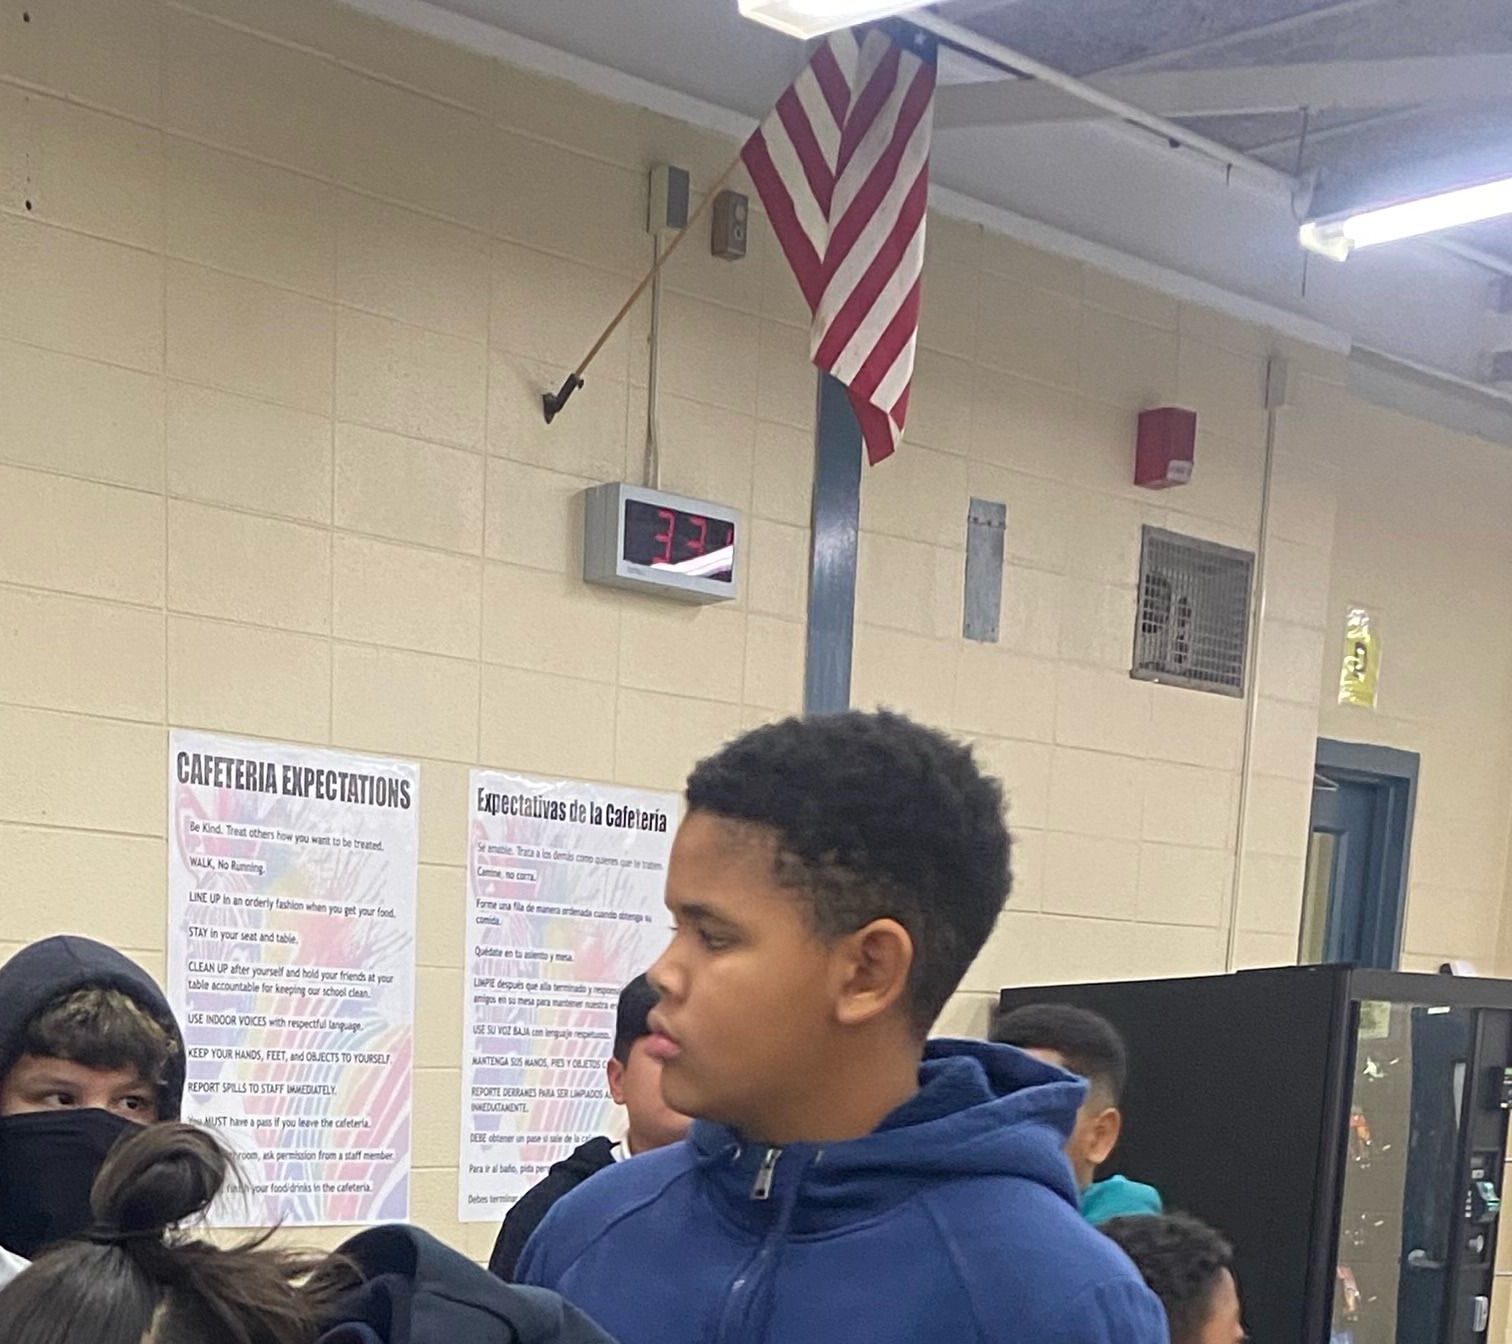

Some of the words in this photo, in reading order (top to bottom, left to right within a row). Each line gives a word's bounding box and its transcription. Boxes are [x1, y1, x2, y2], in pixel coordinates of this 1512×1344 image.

[176, 751, 277, 794] CAFETERIA
[282, 765, 411, 809] EXPECTATIONS
[477, 788, 566, 822] Expectativas
[569, 800, 586, 823] de
[590, 802, 602, 825] la
[606, 804, 667, 833] Cafetería
[190, 821, 200, 832] Be
[202, 823, 223, 835] Kind.
[227, 825, 246, 837] Treat
[249, 827, 274, 840] others
[277, 830, 293, 842] how
[295, 832, 309, 844] you
[312, 833, 330, 846] want
[333, 835, 340, 846] to
[343, 836, 352, 847] be
[354, 838, 384, 851] treated.
[190, 856, 215, 870] WALK,
[218, 859, 229, 870] No
[231, 860, 265, 875] Running.
[189, 891, 207, 903] LINE
[210, 893, 221, 904] UP
[223, 894, 231, 905] in
[233, 896, 243, 906] an
[245, 896, 274, 910] orderly
[276, 898, 303, 911] fashion
[306, 902, 326, 912] when
[329, 904, 342, 915] you
[344, 904, 356, 916] get
[358, 906, 375, 917] your
[377, 906, 396, 918] food.
[189, 927, 208, 938] STAY
[211, 928, 218, 938] in
[221, 931, 239, 941] your
[241, 931, 257, 941] seat
[260, 931, 274, 942] and
[277, 932, 298, 944] table.
[188, 961, 215, 973] CLEAN
[217, 963, 228, 973] UP
[231, 964, 249, 975] after
[252, 966, 284, 978] yourself
[286, 967, 300, 978] and
[303, 968, 319, 979] hold
[321, 971, 338, 982] your
[340, 970, 366, 982] friends
[368, 973, 375, 983] at
[377, 974, 393, 984] your
[188, 979, 209, 991] table
[211, 981, 260, 993] accountable
[262, 983, 273, 993] for
[275, 984, 305, 997] keeping
[308, 987, 320, 996] our
[323, 985, 346, 998] school
[348, 987, 371, 998] clean.
[188, 1013, 203, 1024] USE
[206, 1014, 236, 1026] INDOOR
[239, 1015, 267, 1027] VOICES
[269, 1017, 286, 1028] with
[288, 1018, 326, 1030] respectful
[329, 1019, 364, 1033] language.
[188, 1048, 209, 1058] KEEP
[211, 1049, 233, 1060] YOUR
[235, 1049, 264, 1061] HANDS,
[267, 1050, 288, 1062] FEET,
[291, 1051, 304, 1061] and
[306, 1051, 340, 1063] OBJECTS
[341, 1052, 352, 1063] TO
[354, 1052, 392, 1064] YOURSELF.
[188, 1082, 220, 1093] REPORT
[222, 1083, 247, 1093] SPILLS
[249, 1083, 259, 1093] TO
[261, 1083, 285, 1094] STAFF
[287, 1084, 337, 1096] IMMEDIATELY.
[204, 1116, 227, 1127] MUST
[230, 1117, 248, 1127] have
[250, 1119, 255, 1127] a
[257, 1118, 272, 1129] pass
[274, 1117, 280, 1127] if
[282, 1119, 296, 1129] you
[298, 1117, 319, 1128] leave
[321, 1117, 334, 1128] the
[336, 1117, 371, 1128] cafeteria.
[263, 1151, 274, 1161] ask
[276, 1150, 316, 1163] permission
[318, 1150, 337, 1161] from
[339, 1153, 343, 1161] a
[345, 1150, 362, 1161] staff
[364, 1151, 394, 1162] member.
[314, 1183, 320, 1193] in
[323, 1183, 335, 1193] the
[337, 1182, 372, 1194] cafeteria.
